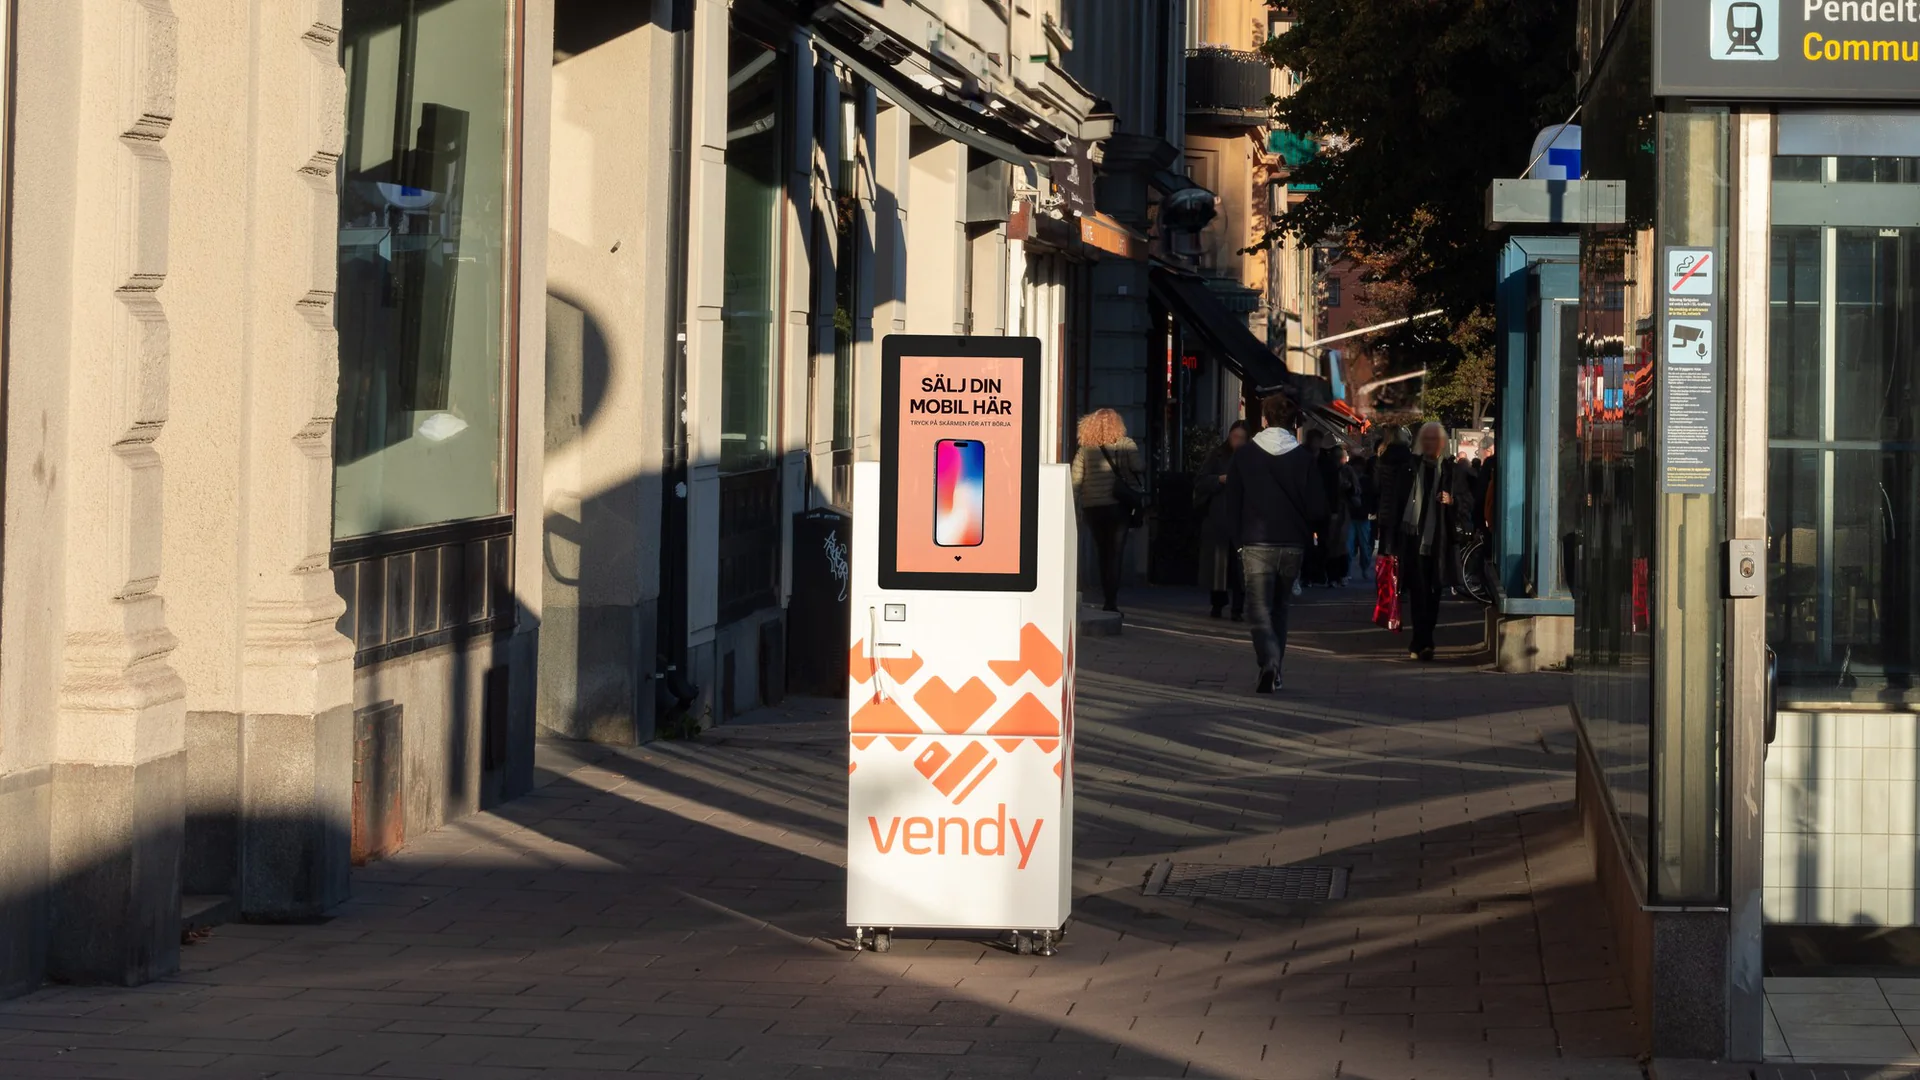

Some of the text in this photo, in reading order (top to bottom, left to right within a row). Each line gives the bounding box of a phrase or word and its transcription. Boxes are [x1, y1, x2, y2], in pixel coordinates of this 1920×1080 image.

[1803, 0, 1920, 22] Pendelt
[1803, 32, 1919, 61] Commu
[921, 374, 1001, 393] SÄLJ DIN
[910, 396, 1012, 415] MOBIL HÄR
[868, 803, 1044, 870] vendy
